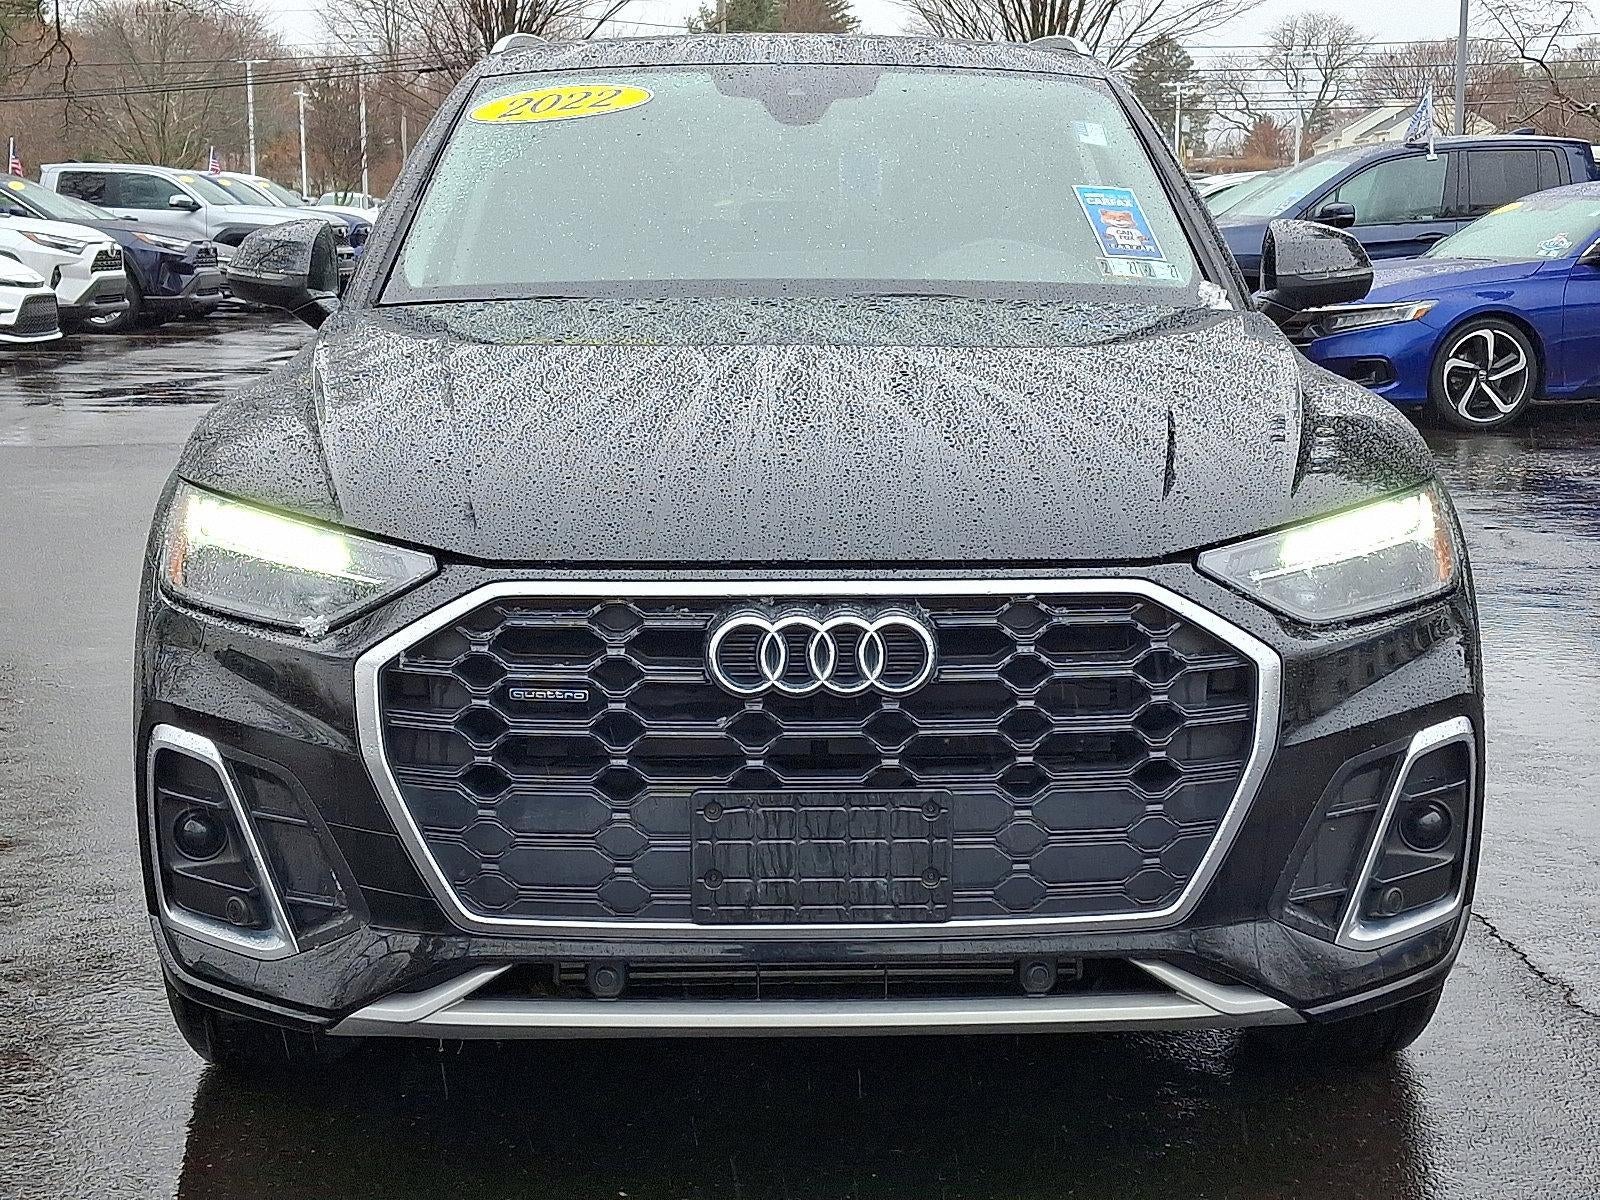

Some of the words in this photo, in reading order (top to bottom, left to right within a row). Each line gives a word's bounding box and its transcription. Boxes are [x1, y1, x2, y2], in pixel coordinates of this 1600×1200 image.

[498, 89, 622, 118] 2022
[1085, 197, 1135, 208] CARFAX
[512, 690, 585, 700] quattro
